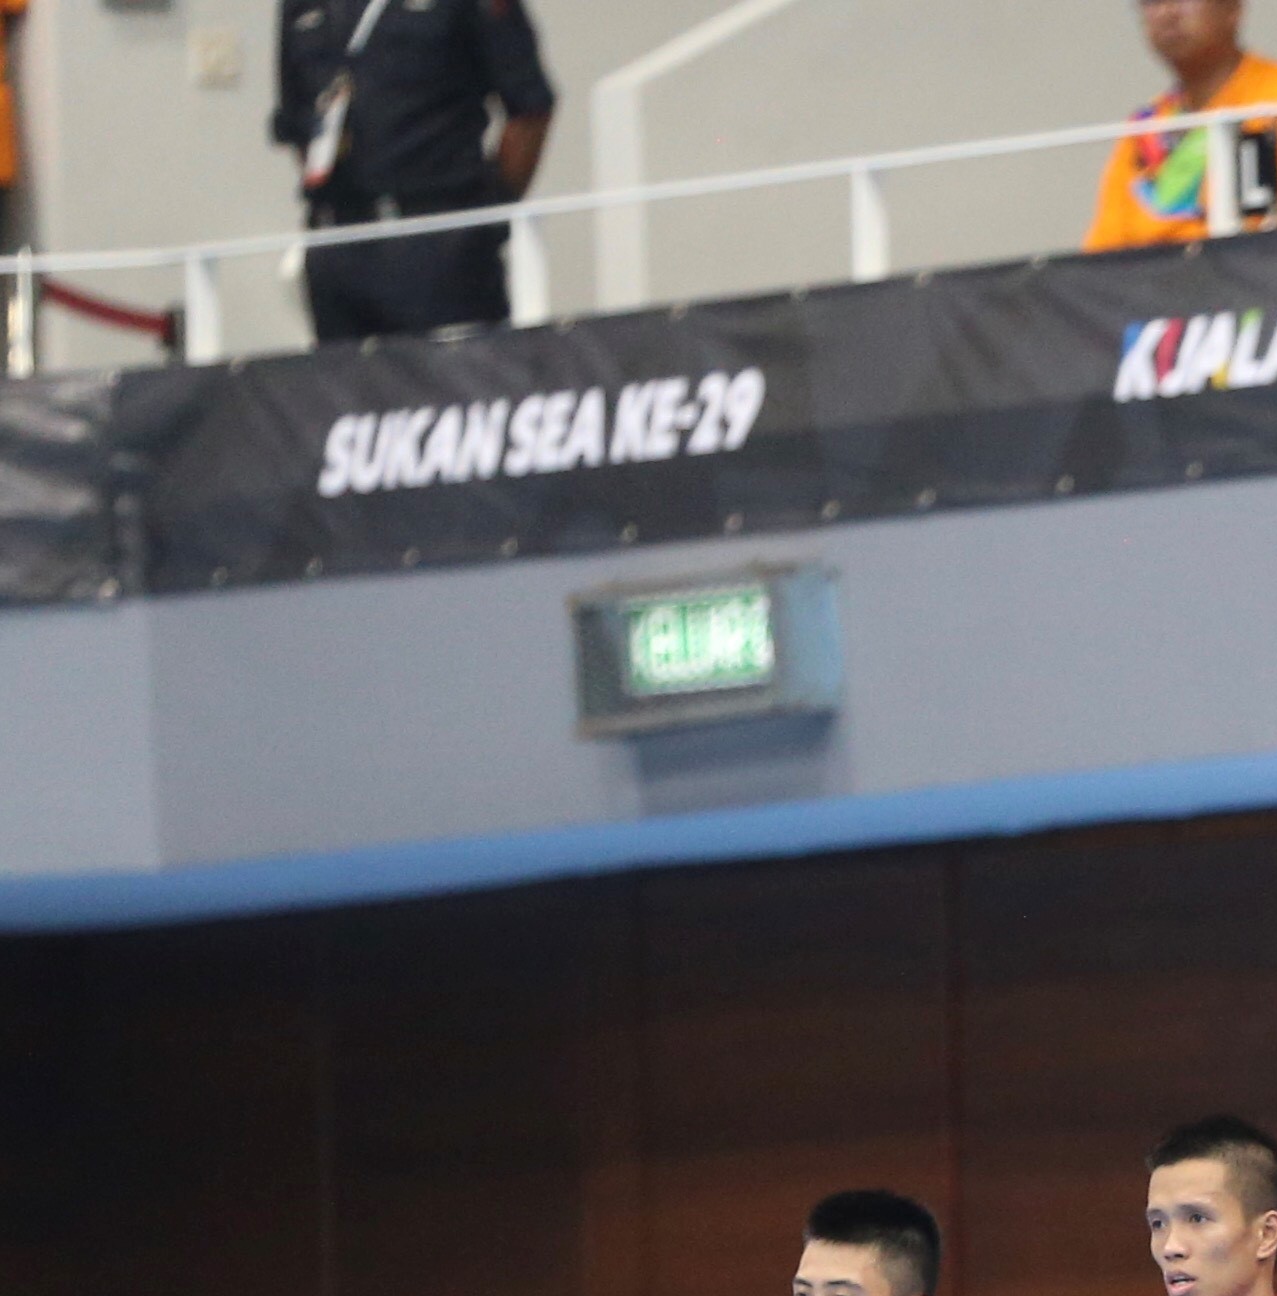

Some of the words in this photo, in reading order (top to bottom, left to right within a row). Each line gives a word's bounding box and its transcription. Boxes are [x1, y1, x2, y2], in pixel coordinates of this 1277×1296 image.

[316, 398, 511, 499] SUKAN
[503, 386, 606, 478] SEA
[609, 365, 767, 465] KE-29
